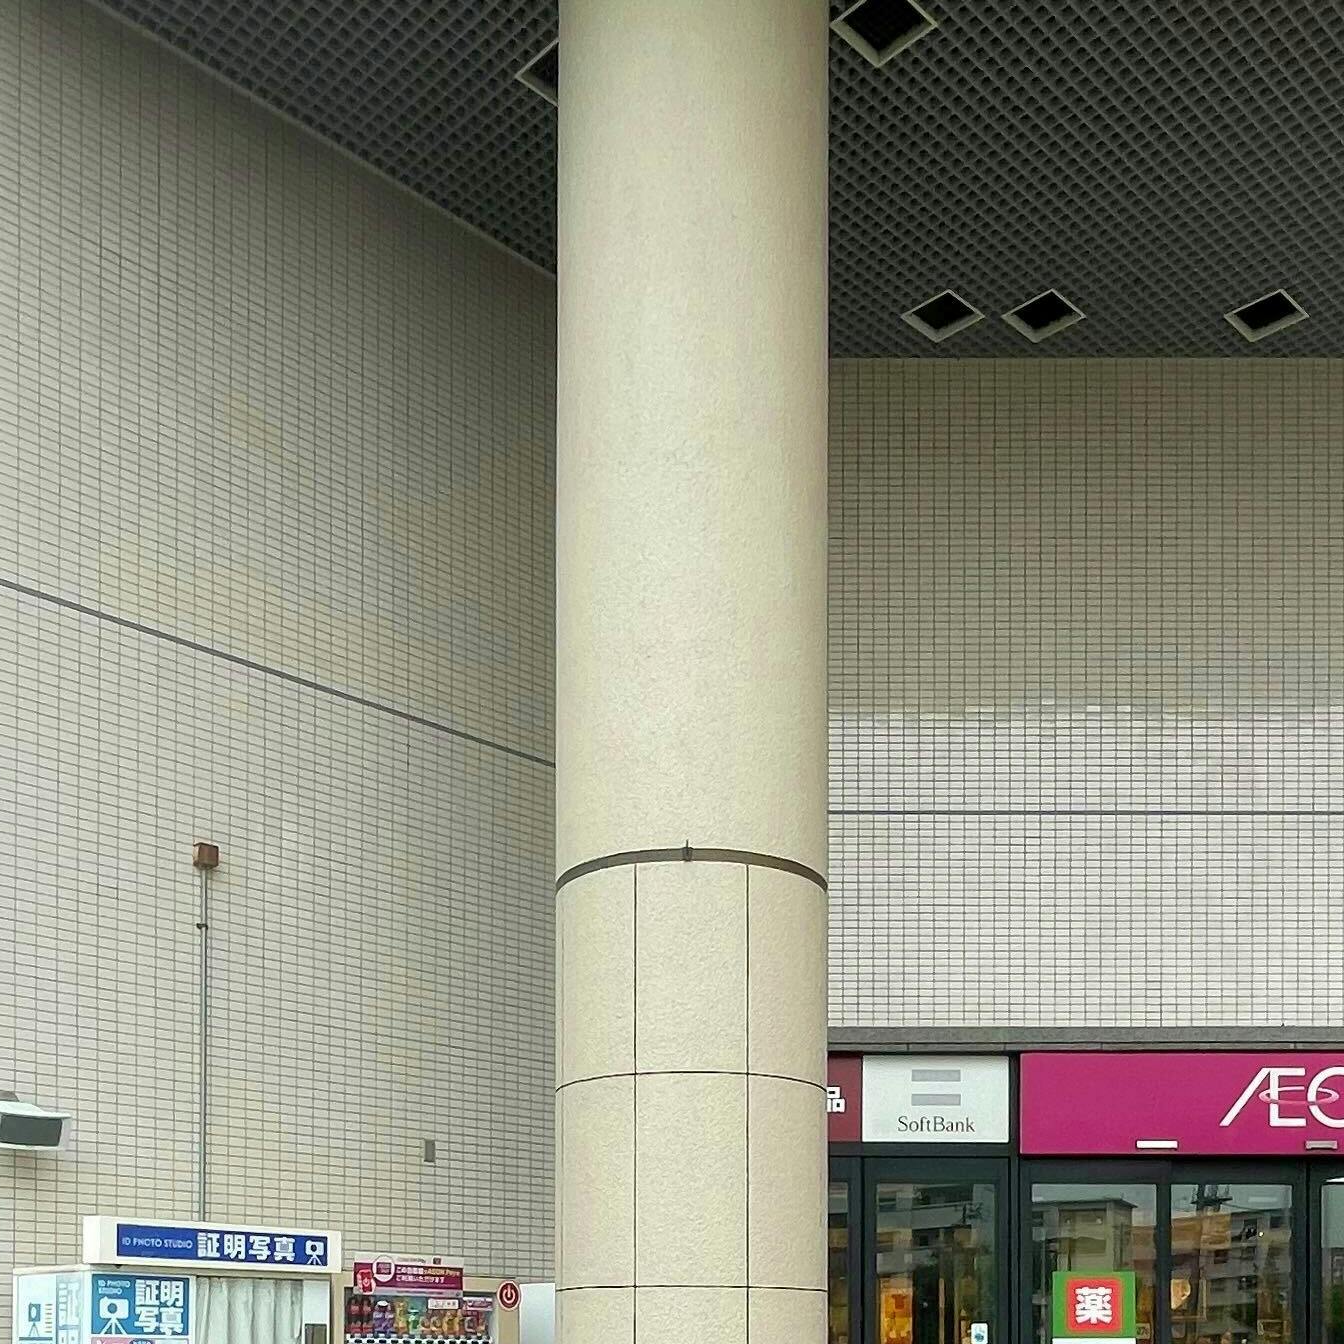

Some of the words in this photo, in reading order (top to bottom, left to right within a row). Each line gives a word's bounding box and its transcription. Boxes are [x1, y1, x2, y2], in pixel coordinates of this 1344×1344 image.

[897, 1115, 976, 1133] SoftBank
[122, 1237, 131, 1247] ID
[132, 1238, 163, 1248] PHOTO
[163, 1239, 193, 1249] STUDIO
[197, 1231, 296, 1262] 証明写真
[135, 1279, 184, 1307] 証明
[1074, 1286, 1113, 1325] 薬
[134, 1306, 184, 1336] 写真
